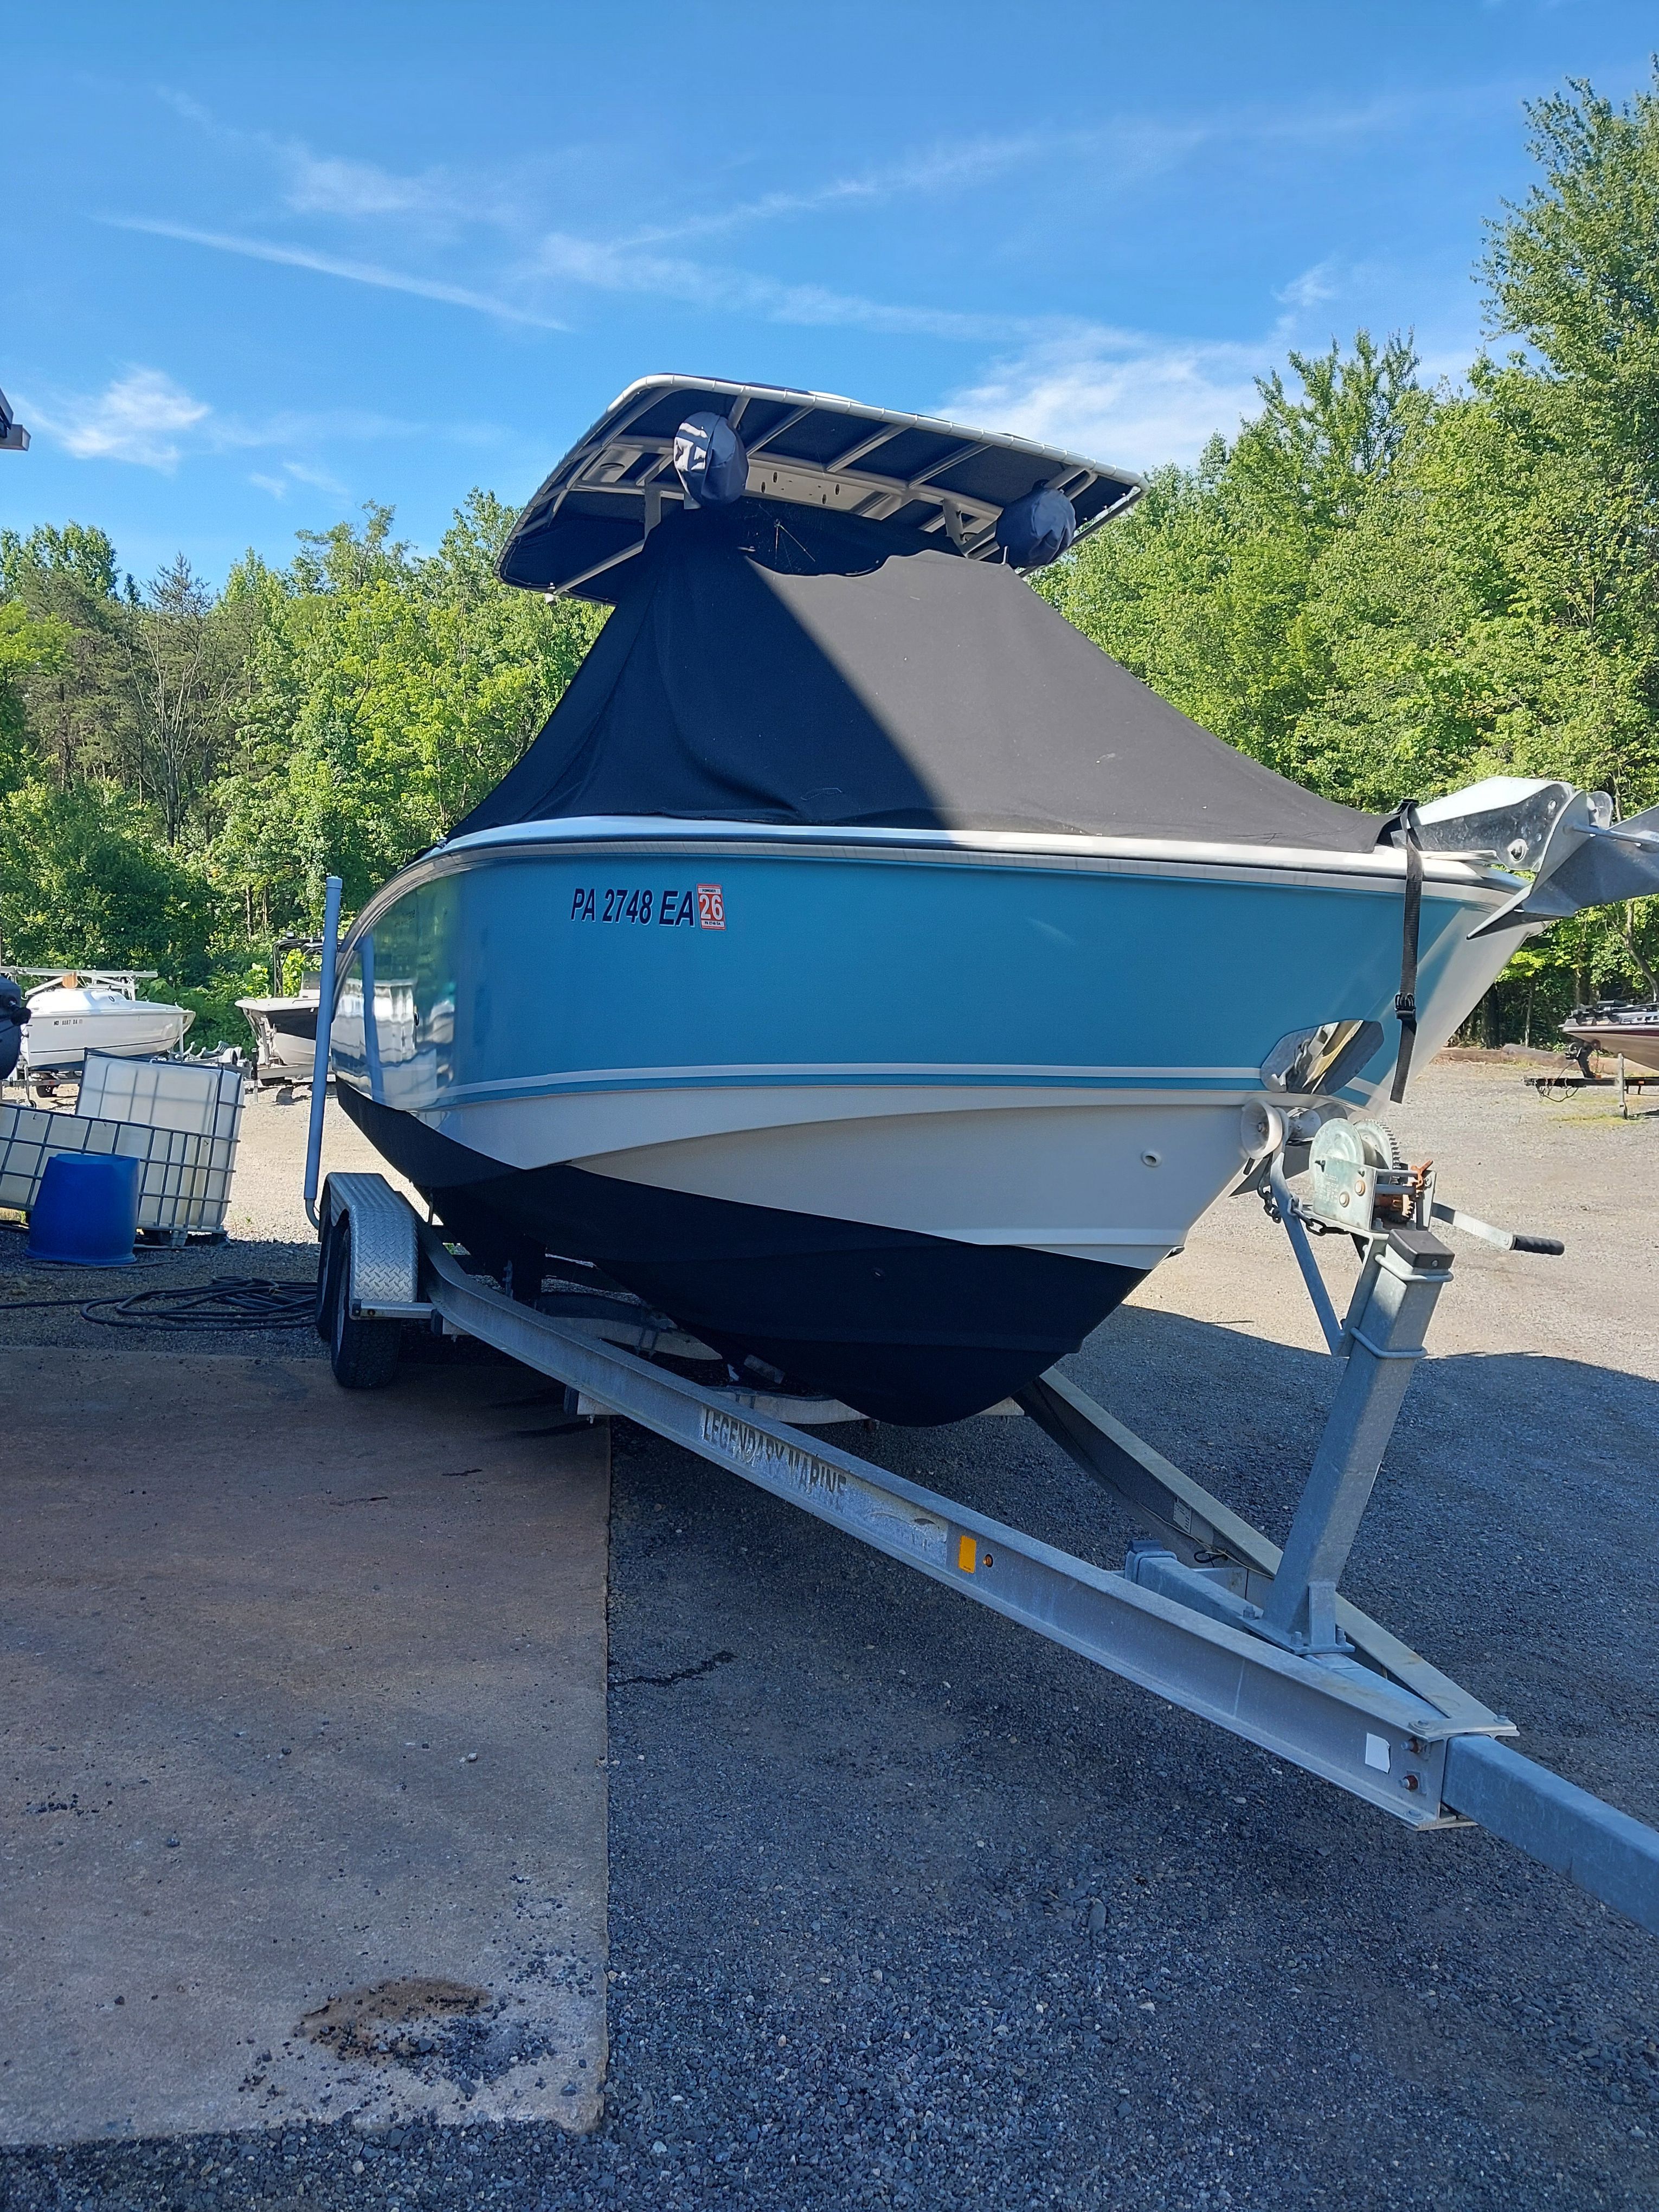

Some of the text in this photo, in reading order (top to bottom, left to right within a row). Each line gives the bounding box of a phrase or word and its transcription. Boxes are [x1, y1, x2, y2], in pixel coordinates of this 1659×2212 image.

[571, 888, 695, 927] PA 2748 EA
[699, 894, 723, 920] 26
[703, 1409, 847, 1495] LEGENDARY MARINE
